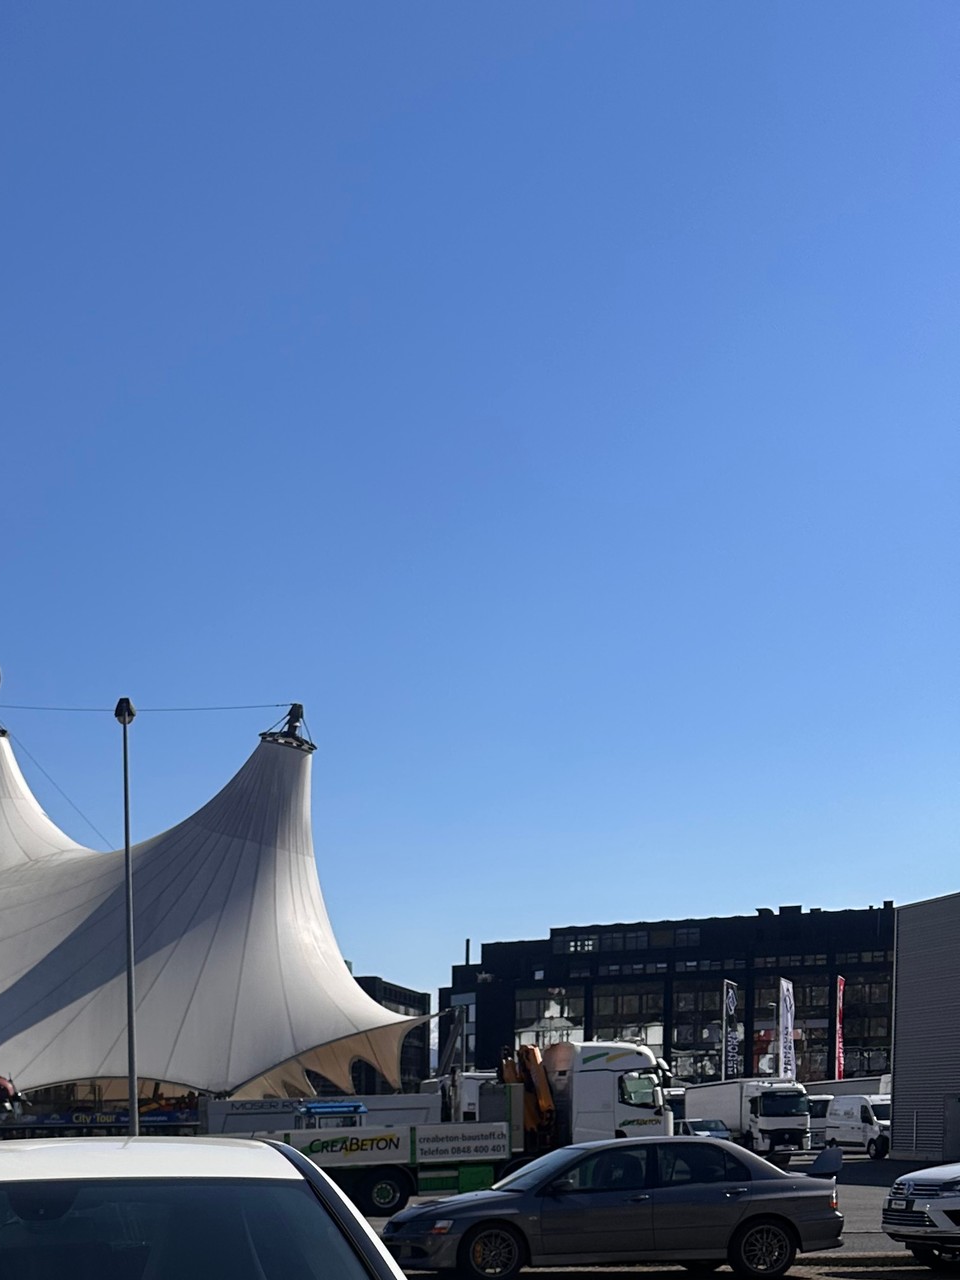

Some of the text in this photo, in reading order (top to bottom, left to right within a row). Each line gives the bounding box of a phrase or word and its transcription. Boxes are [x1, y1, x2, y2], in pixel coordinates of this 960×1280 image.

[231, 1102, 279, 1111] MOSER
[72, 1113, 92, 1124] City
[95, 1112, 116, 1123] Tour
[419, 1131, 507, 1144] creabeton-baustoff.ch
[420, 1144, 506, 1156] Telefon 0848 400 401
